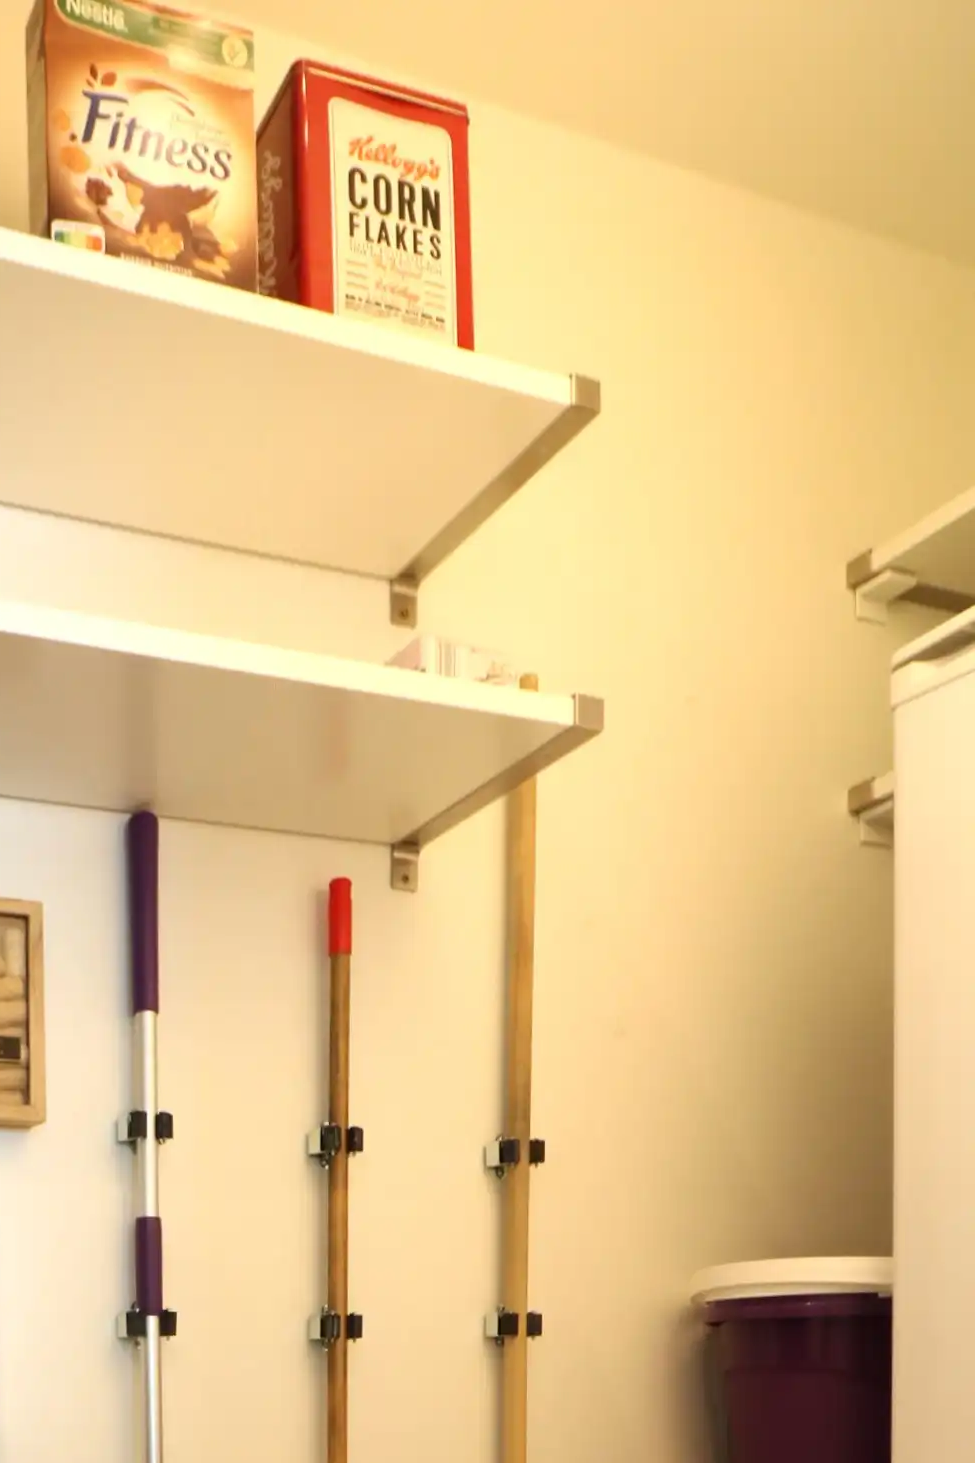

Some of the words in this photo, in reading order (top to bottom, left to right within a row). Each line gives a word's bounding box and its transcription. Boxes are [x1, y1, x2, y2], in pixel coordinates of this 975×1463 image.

[80, 89, 232, 181] Fitness
[348, 135, 441, 182] Kellogg's
[348, 166, 441, 231] CORN
[348, 212, 442, 260] FLAKES
